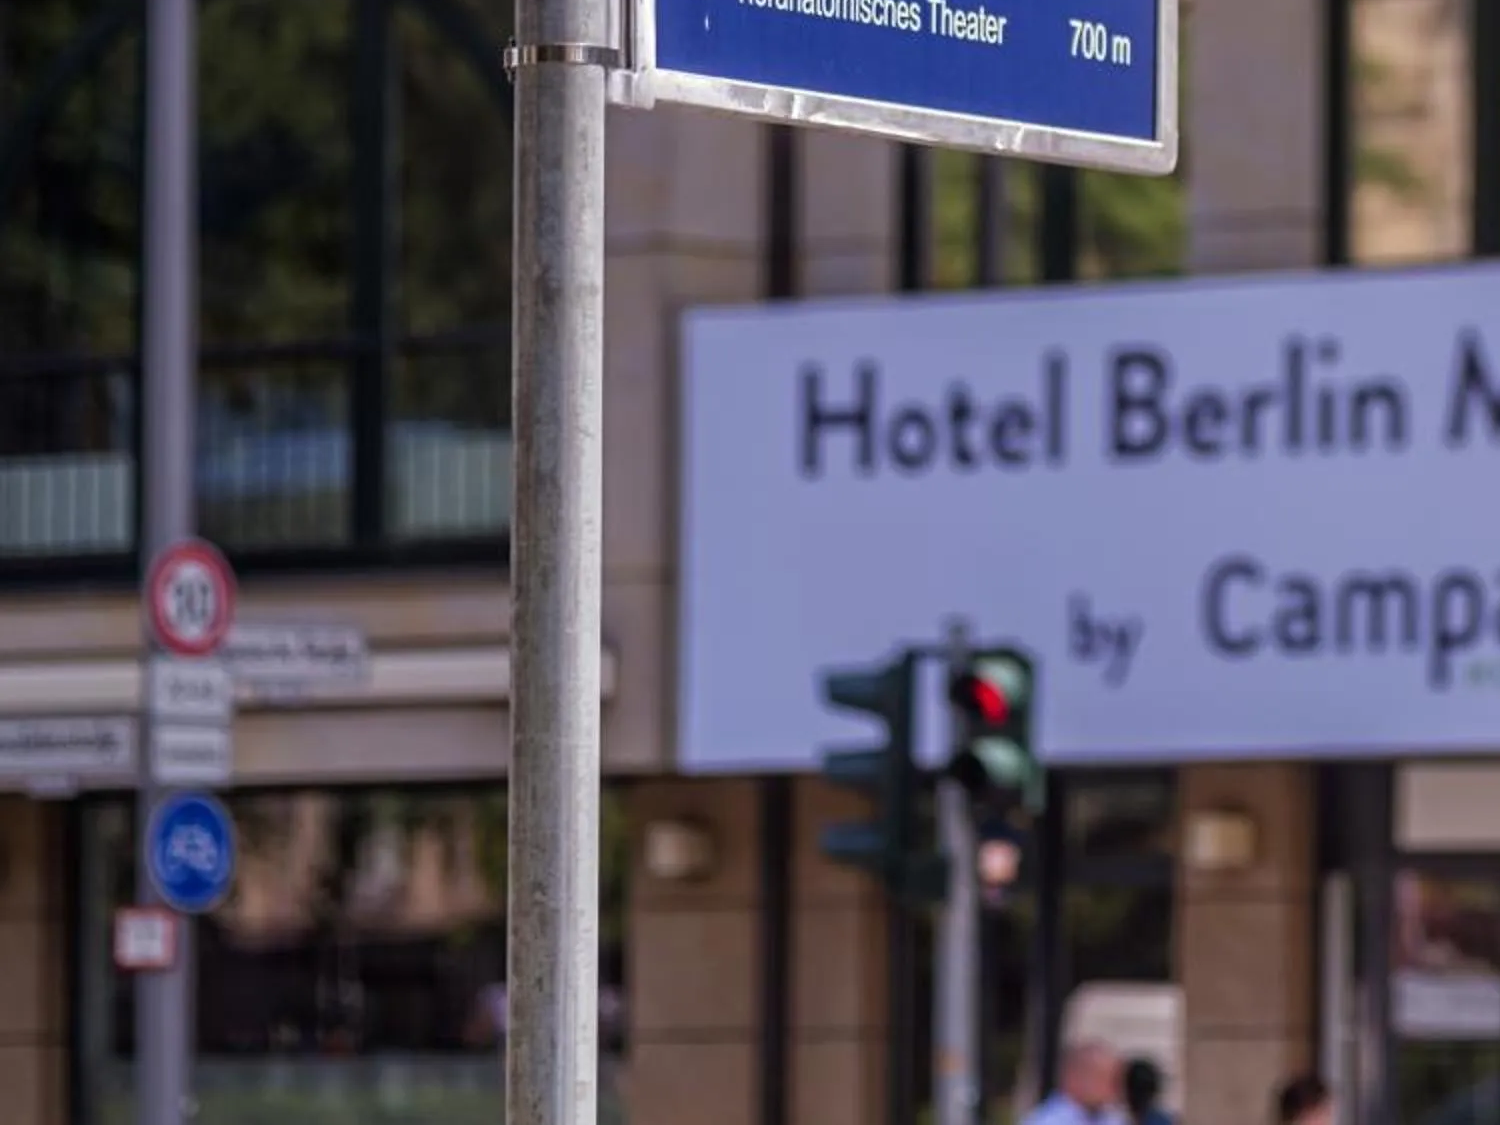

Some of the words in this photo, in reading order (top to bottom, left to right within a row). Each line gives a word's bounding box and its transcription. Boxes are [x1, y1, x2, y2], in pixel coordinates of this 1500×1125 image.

[1068, 17, 1108, 62] 700
[1111, 34, 1132, 66] m
[799, 345, 1068, 477] Hotel
[1106, 337, 1410, 463] Berlin
[1068, 590, 1142, 685] by
